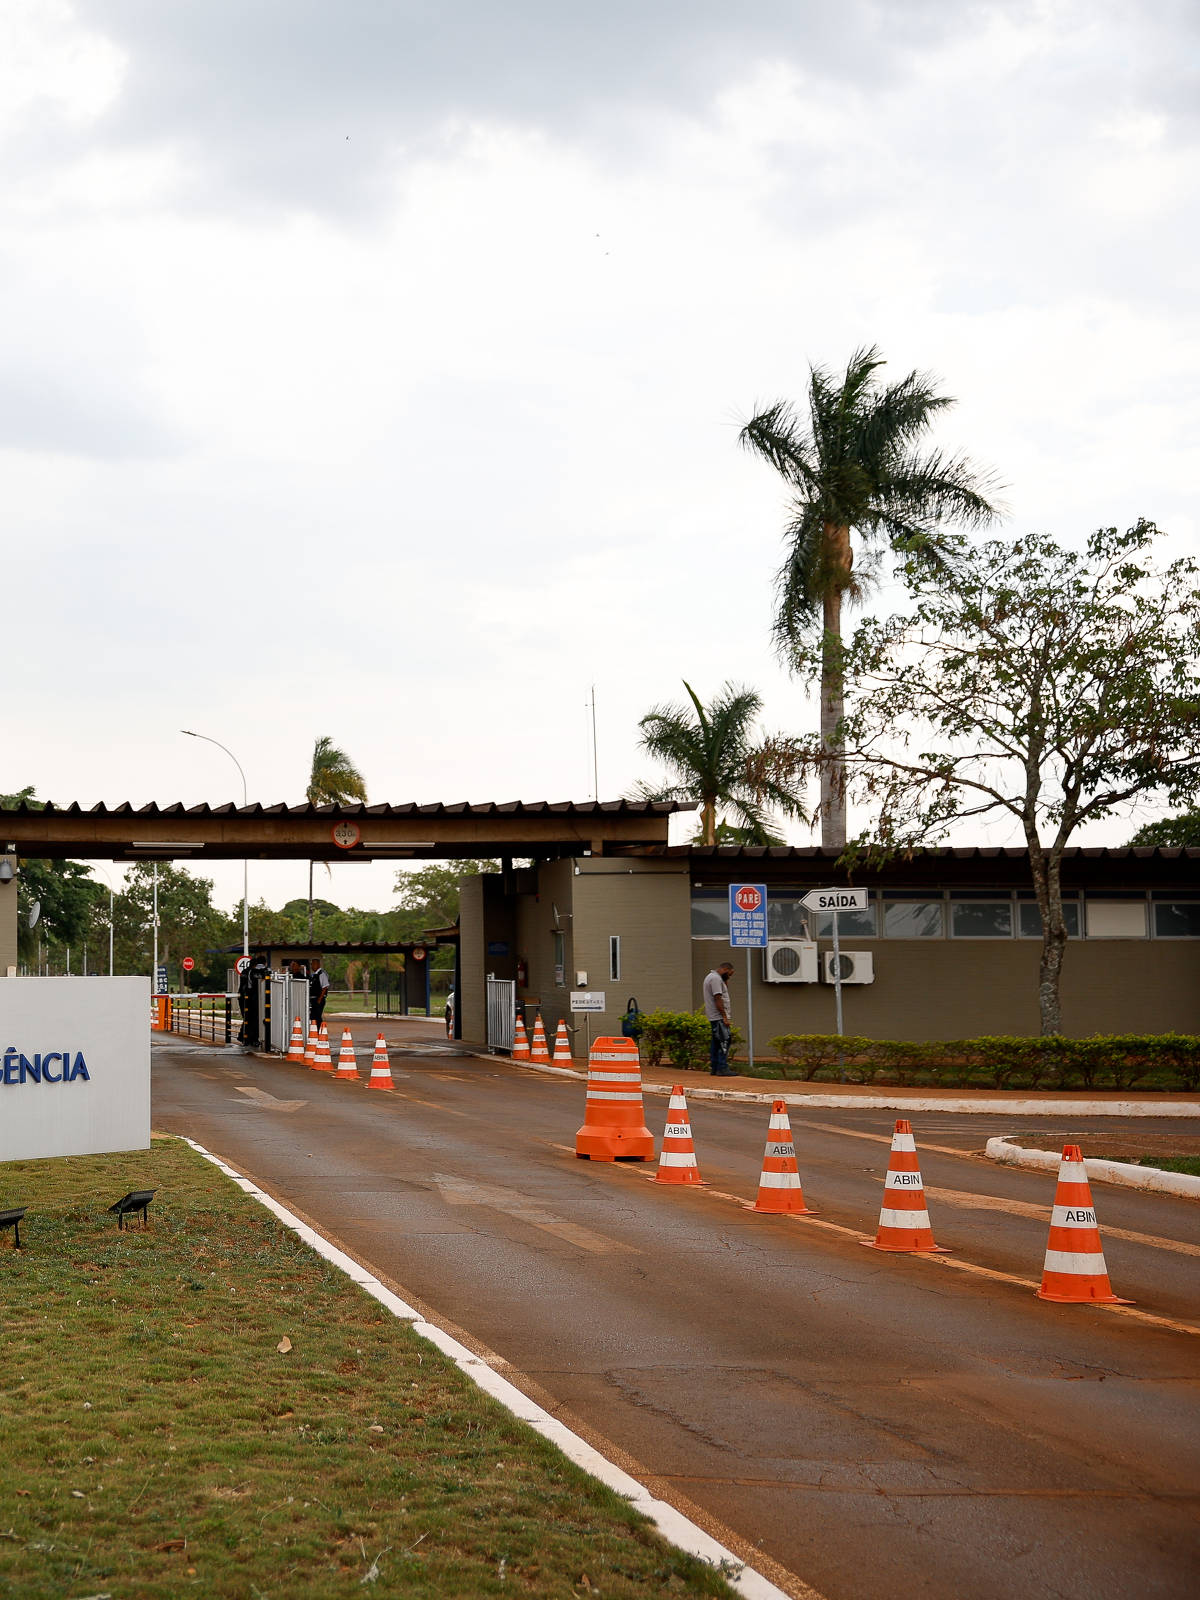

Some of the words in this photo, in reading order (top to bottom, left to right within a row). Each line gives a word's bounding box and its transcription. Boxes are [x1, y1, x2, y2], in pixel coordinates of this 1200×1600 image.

[738, 893, 759, 904] PARE
[819, 892, 857, 907] SAÍDA
[667, 1127, 688, 1135] ABIN
[893, 1175, 920, 1185] ABIN
[1065, 1210, 1096, 1223] ABIN
